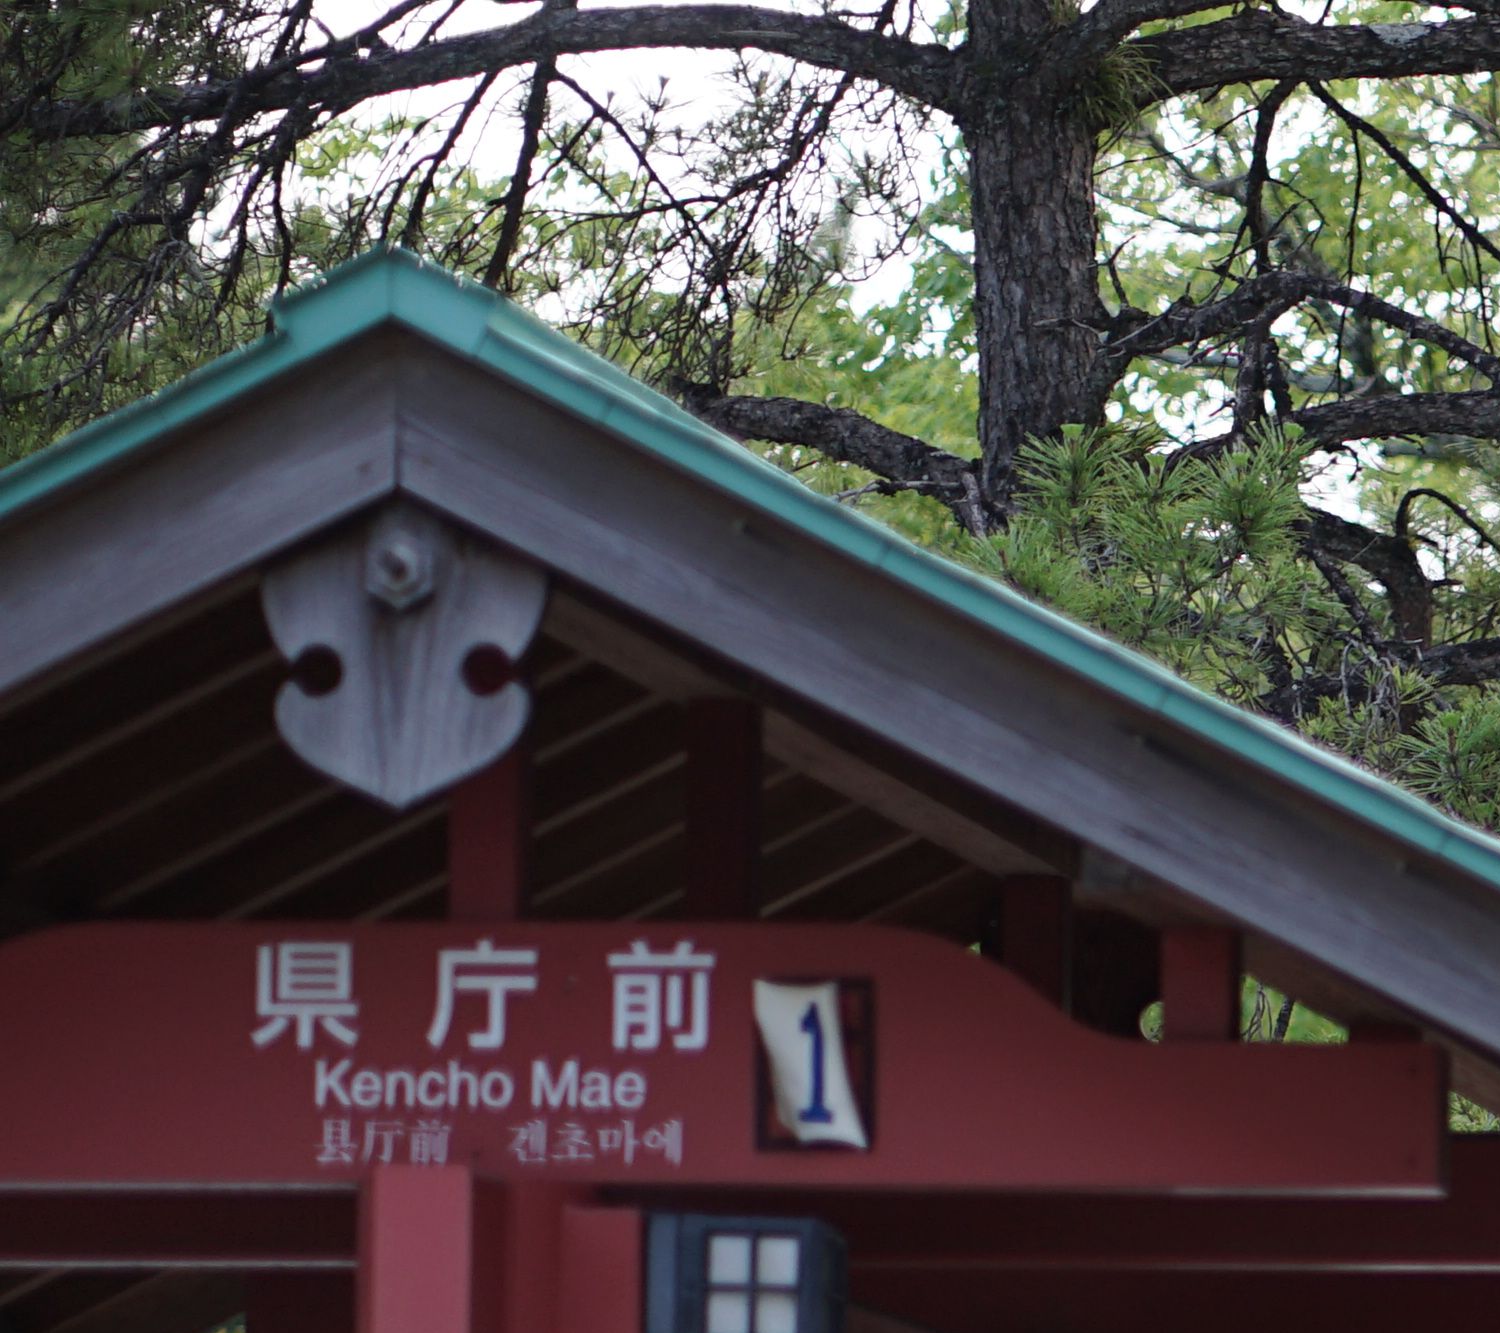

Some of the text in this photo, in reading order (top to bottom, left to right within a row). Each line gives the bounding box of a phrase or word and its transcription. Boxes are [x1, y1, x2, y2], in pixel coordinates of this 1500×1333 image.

[250, 940, 716, 1051] 県庁前
[315, 1059, 647, 1109] Kencho Mae
[799, 1001, 832, 1124] 1
